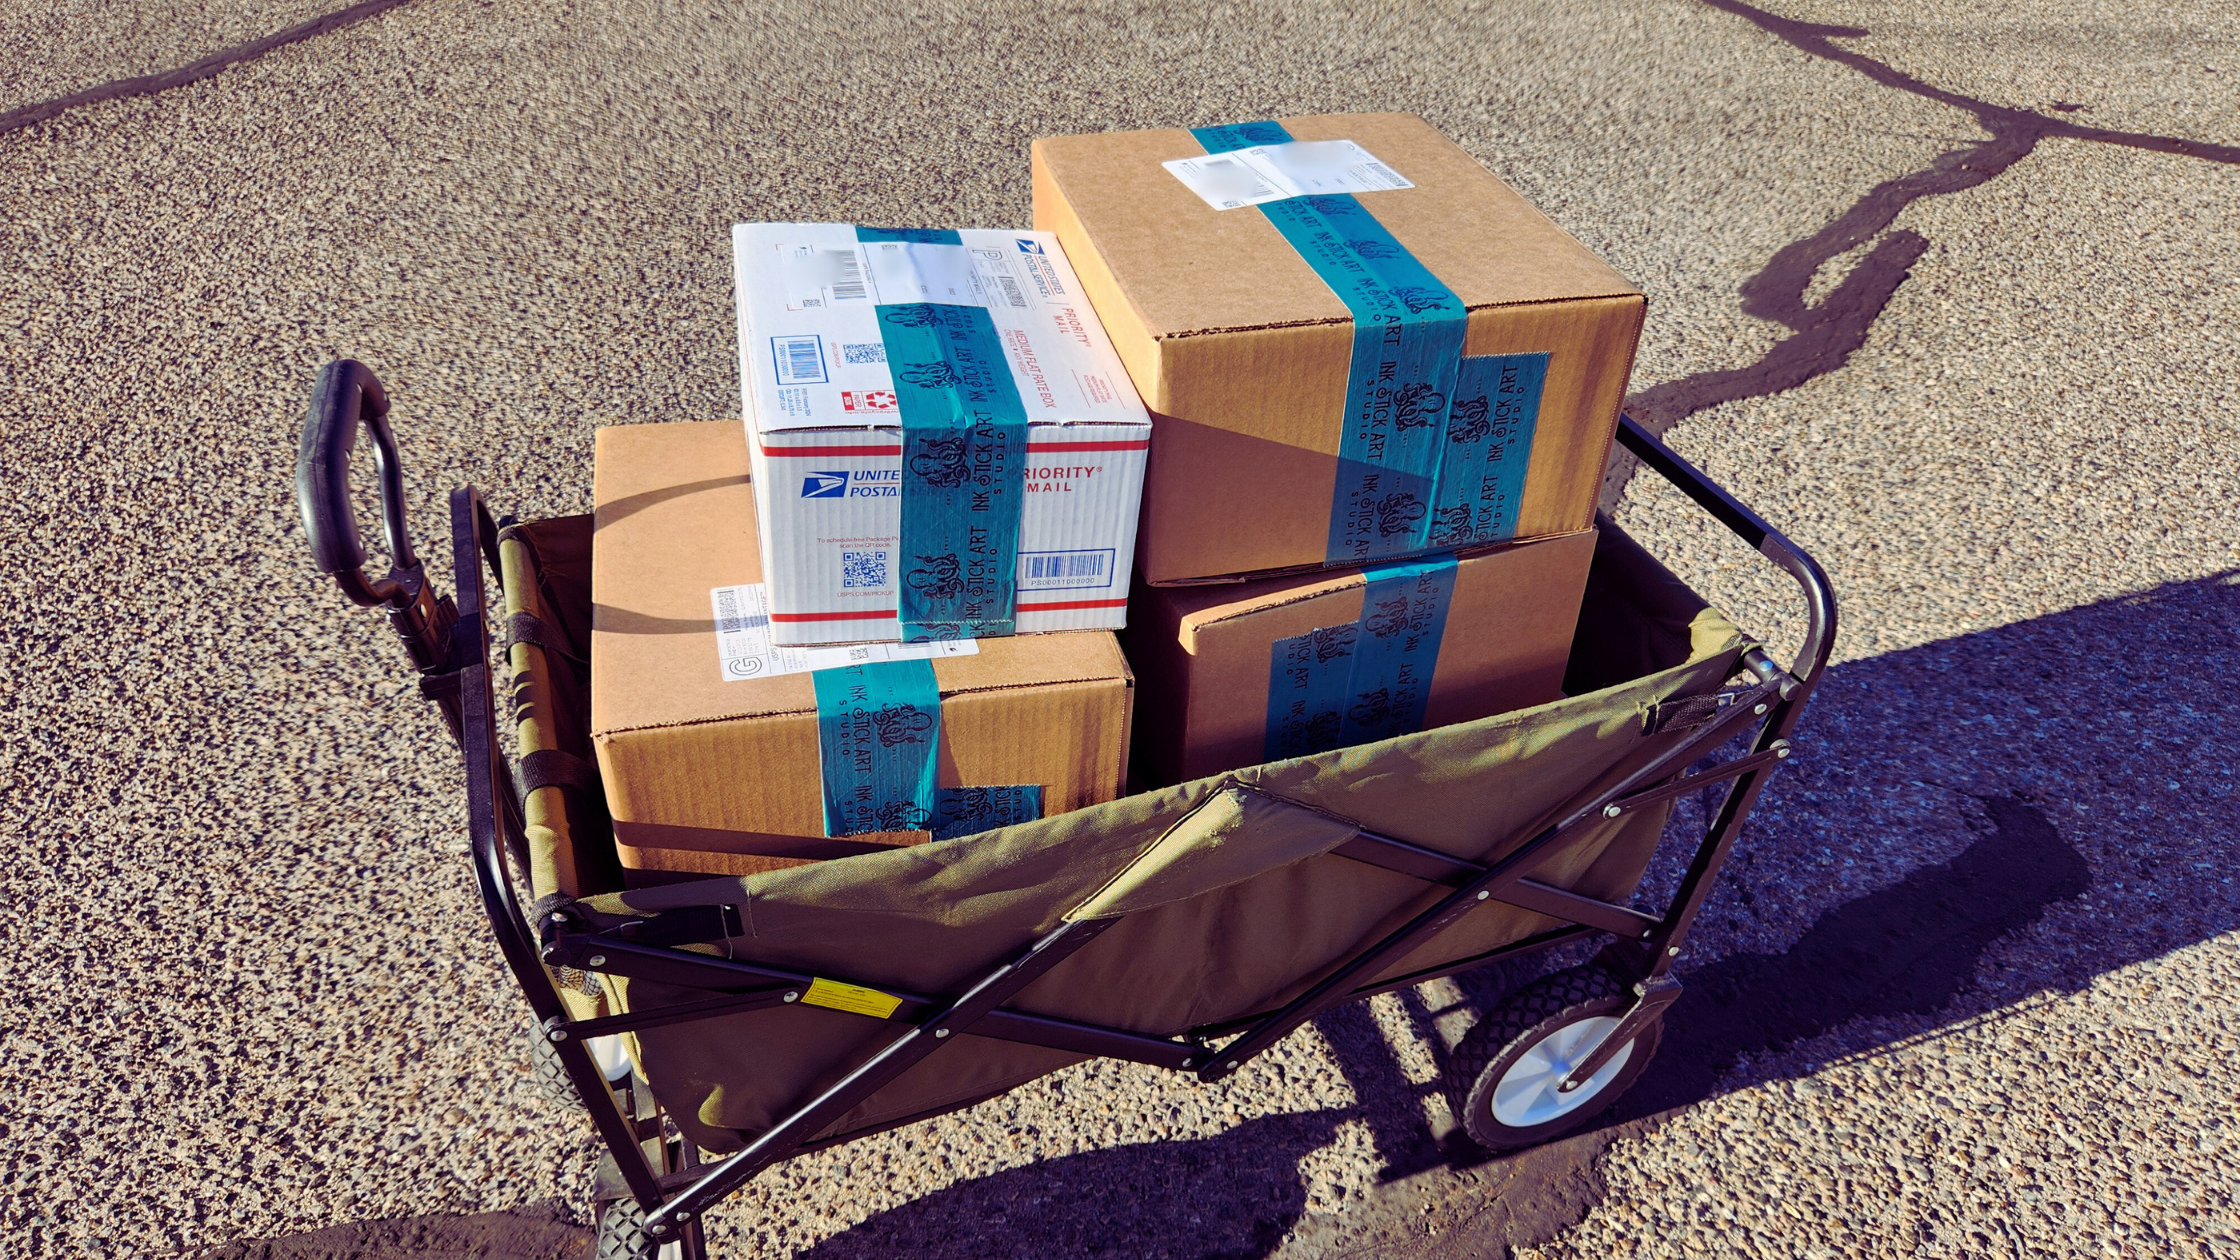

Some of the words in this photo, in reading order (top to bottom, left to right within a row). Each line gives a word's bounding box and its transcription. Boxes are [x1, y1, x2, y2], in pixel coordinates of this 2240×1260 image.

[1275, 202, 1296, 221] TUDIO
[1309, 241, 1337, 265] STUDIO
[1339, 260, 1365, 272] ART
[1357, 278, 1379, 289] INK
[1352, 287, 1381, 321] STUDIO
[1367, 290, 1397, 311] STICK
[1053, 315, 1070, 334] MAIL
[1384, 314, 1402, 347] ART
[954, 346, 975, 364] ART
[1013, 329, 1034, 356] MEDIUM
[960, 365, 983, 388] STICK
[978, 360, 997, 393] STUDIO
[1024, 356, 1042, 374] FLAT
[1378, 361, 1397, 382] INK
[1032, 373, 1050, 392] RATE
[1501, 364, 1519, 394] ART
[967, 389, 988, 403] INK
[1040, 392, 1057, 409] BOX
[1370, 387, 1392, 430] STICK
[1359, 380, 1375, 440] STUDIO
[1491, 398, 1511, 437] STICK
[1507, 386, 1525, 445] STUDIO
[973, 409, 994, 439] ART
[1367, 433, 1386, 461] ART
[1486, 442, 1504, 464] INK
[853, 470, 900, 481] UNITE
[973, 443, 993, 487] STICK
[993, 431, 1006, 495] STUDIO
[850, 486, 900, 497] POSTA
[1027, 482, 1072, 493] MAIL
[1362, 473, 1380, 494] INK
[1480, 474, 1499, 501] ART
[971, 490, 990, 512] INK
[1345, 491, 1359, 546] STUDIO
[1357, 497, 1376, 536] STICK
[1474, 504, 1493, 540] STICK
[969, 525, 988, 555] ART
[966, 554, 986, 598] STICK
[985, 548, 998, 604] STUDIO
[1418, 569, 1434, 594] ART
[965, 600, 983, 620] INK
[1409, 597, 1427, 632] STICK
[1422, 587, 1439, 637] STUDIO
[1404, 633, 1419, 651] INK
[728, 656, 763, 676] G
[1286, 643, 1296, 675] UDIO
[1294, 667, 1309, 690] ART
[1398, 662, 1414, 685] ART
[848, 684, 868, 702] INK
[1403, 677, 1418, 723] STUDIO
[1291, 700, 1306, 718] INK
[838, 700, 850, 756] STUDIO
[852, 707, 871, 746] STICK
[854, 749, 872, 774] ART
[855, 784, 873, 803] INK
